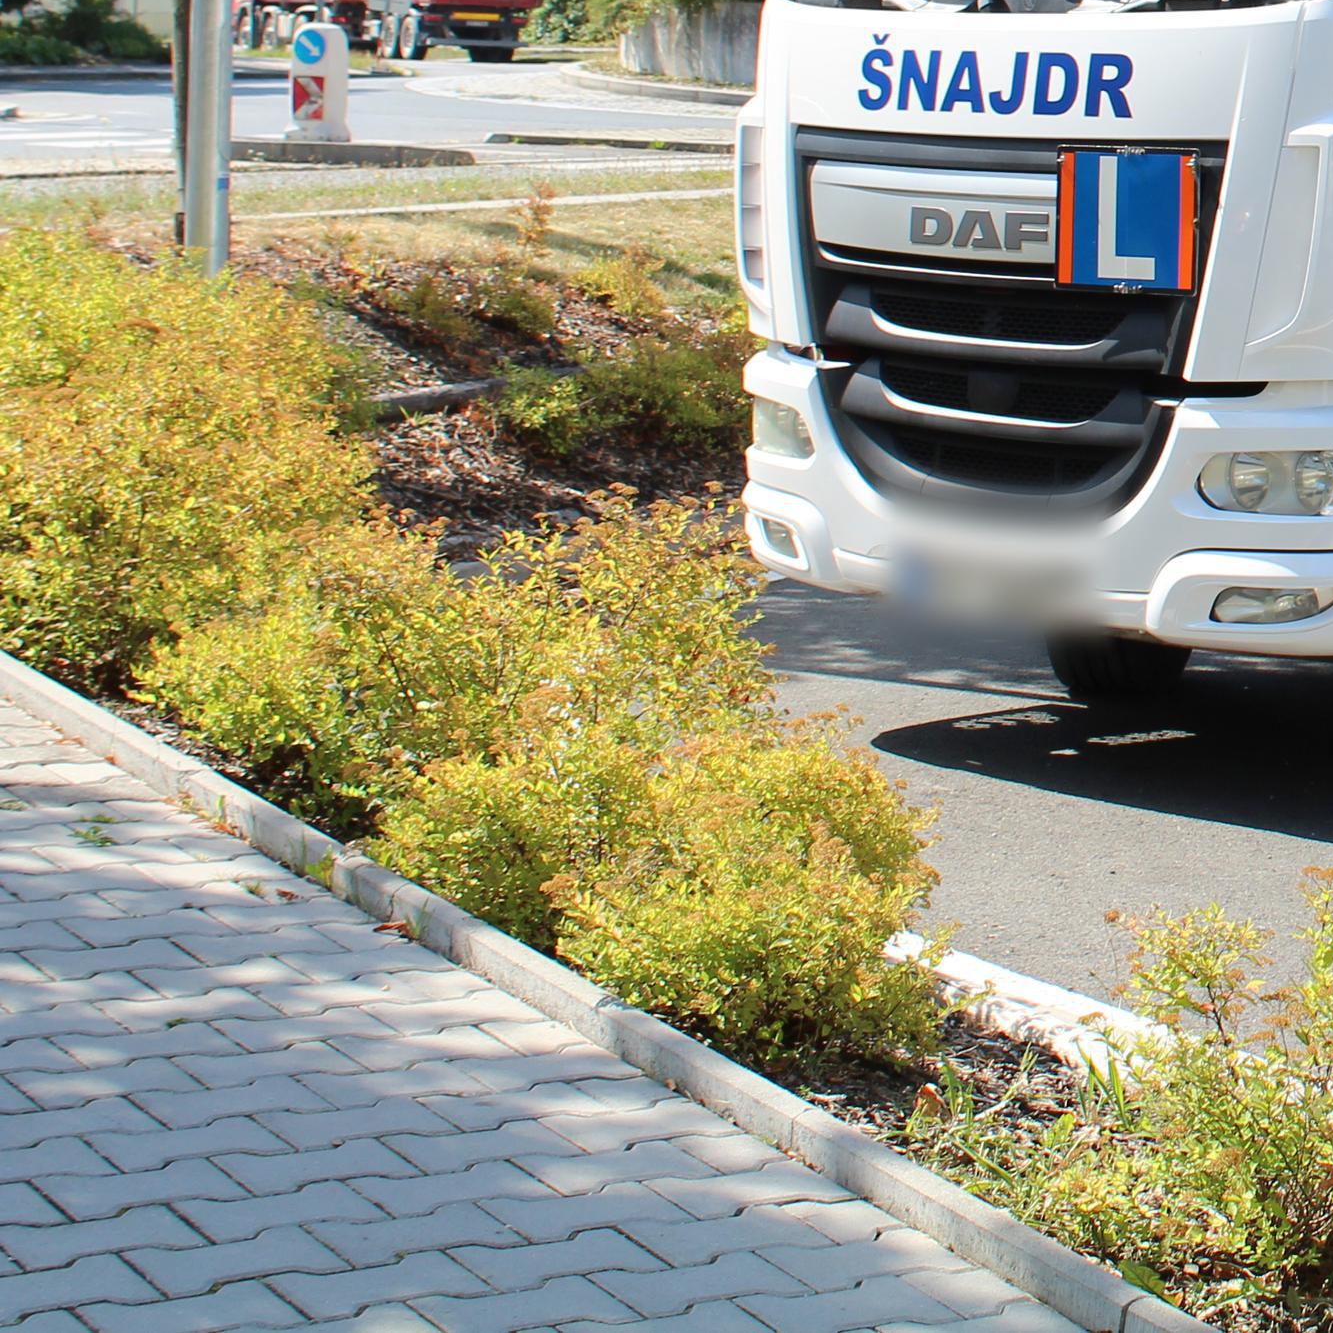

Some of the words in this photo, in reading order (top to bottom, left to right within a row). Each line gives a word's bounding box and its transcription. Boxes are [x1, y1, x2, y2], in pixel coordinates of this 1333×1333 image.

[857, 33, 1133, 119] ŠNAJDR
[910, 205, 1050, 251] DAF
[1097, 154, 1156, 280] L
